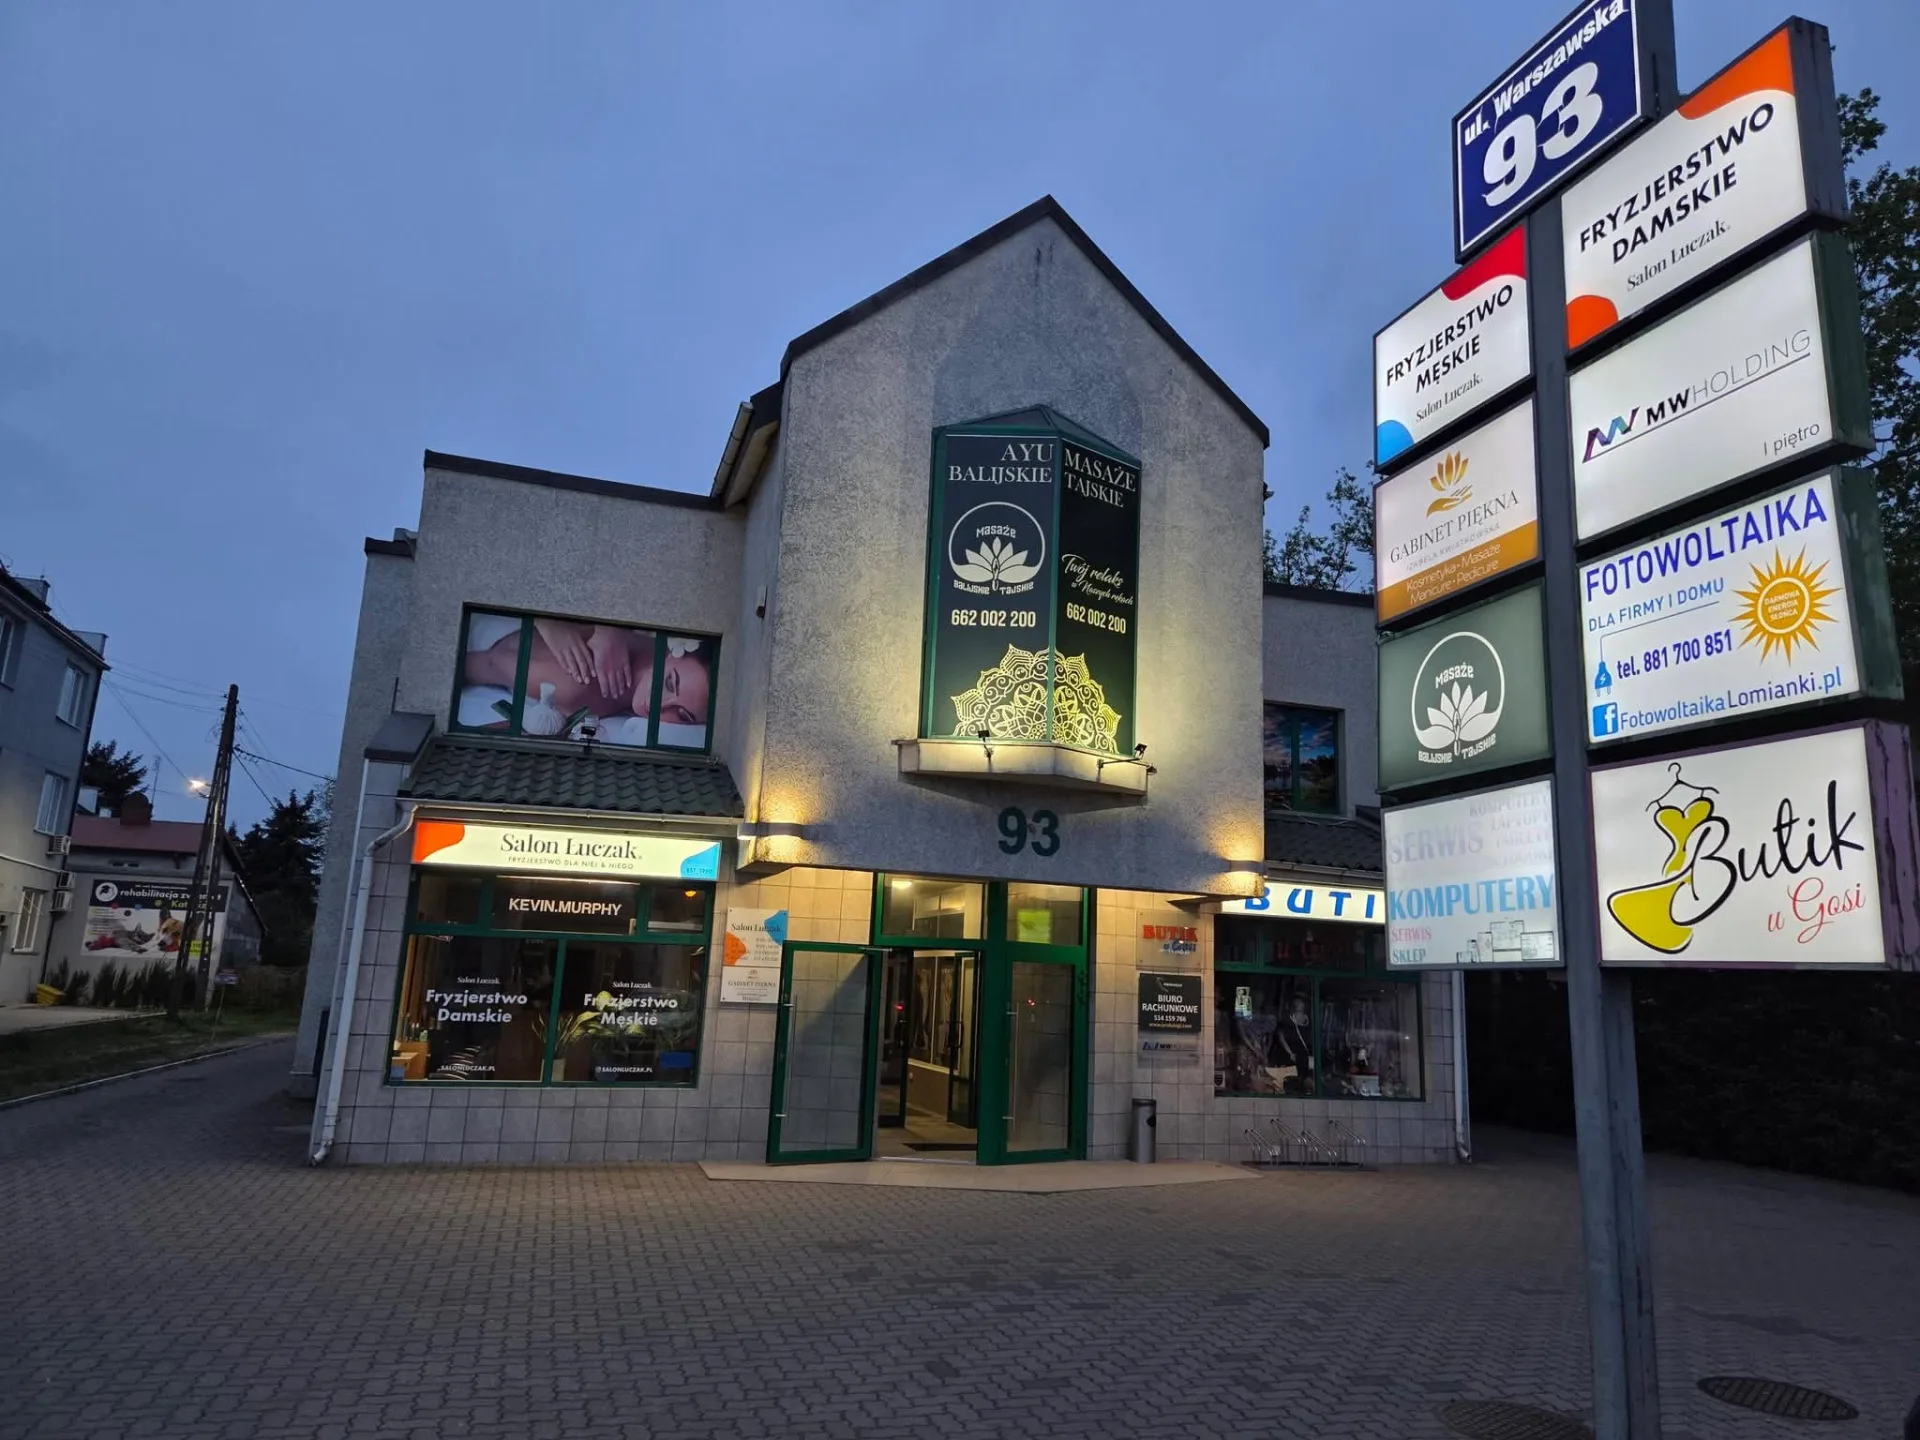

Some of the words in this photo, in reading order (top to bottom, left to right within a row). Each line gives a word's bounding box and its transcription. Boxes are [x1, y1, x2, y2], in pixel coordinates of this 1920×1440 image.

[1464, 106, 1491, 146] ul.
[1493, 0, 1629, 130] Warszawska
[1479, 62, 1603, 208] 93
[1580, 103, 1774, 253] FRYZJERSTWO
[1612, 162, 1737, 264] DAMSKIE
[1627, 257, 1667, 292] Salon
[1386, 285, 1513, 387] FRYZJERSTWO
[1416, 334, 1480, 394] MĘSKIE
[1416, 399, 1442, 422] Salon
[1001, 443, 1053, 462] AYU
[1774, 423, 1820, 455] piętro
[949, 465, 1052, 484] BALIJSKIE
[1064, 448, 1136, 492] MASAŻE
[1064, 472, 1124, 508] TAJSKIE
[1390, 520, 1454, 564] GABINET
[1458, 490, 1519, 532] PIĘKNA
[1585, 487, 1828, 602] FOTOWOLTAIKA
[1090, 568, 1123, 588] relaks
[1406, 563, 1456, 593] Kosmetyka
[951, 609, 977, 626] 662
[981, 610, 1006, 627] 002
[1010, 611, 1036, 627] 200
[1066, 602, 1086, 622] 662
[1088, 608, 1106, 628] 002
[1108, 614, 1126, 634] 200
[1589, 612, 1616, 632] DLA
[1619, 596, 1664, 623] FIRMY
[1668, 594, 1672, 608] I
[1677, 577, 1724, 605] DOMU
[1617, 656, 1640, 679] tel.
[1643, 646, 1667, 672] 881
[1673, 638, 1700, 665] 700
[1704, 629, 1732, 656] 851
[500, 833, 559, 854] Salon
[998, 806, 1060, 856] 93
[1389, 822, 1483, 865] SERWIS
[508, 856, 561, 866] FRYZJERSTWO
[1669, 779, 1865, 926] Butik
[120, 888, 179, 900] rehabilitacja
[508, 897, 622, 916] KEVIN.MURPHY
[1387, 874, 1554, 921] KOMPUTERY
[1768, 911, 1785, 932] u
[1787, 876, 1866, 944] Gosi
[1142, 924, 1198, 942] BUTIK
[1391, 928, 1432, 942] SERWIS
[1393, 948, 1426, 963] SKLEP
[425, 989, 528, 1007] Fryzjerstwo
[1142, 1003, 1199, 1014] RACHUNKOWE
[1158, 994, 1183, 1003] BIURO
[437, 1008, 512, 1023] Damskie
[601, 1011, 658, 1028] Męskie
